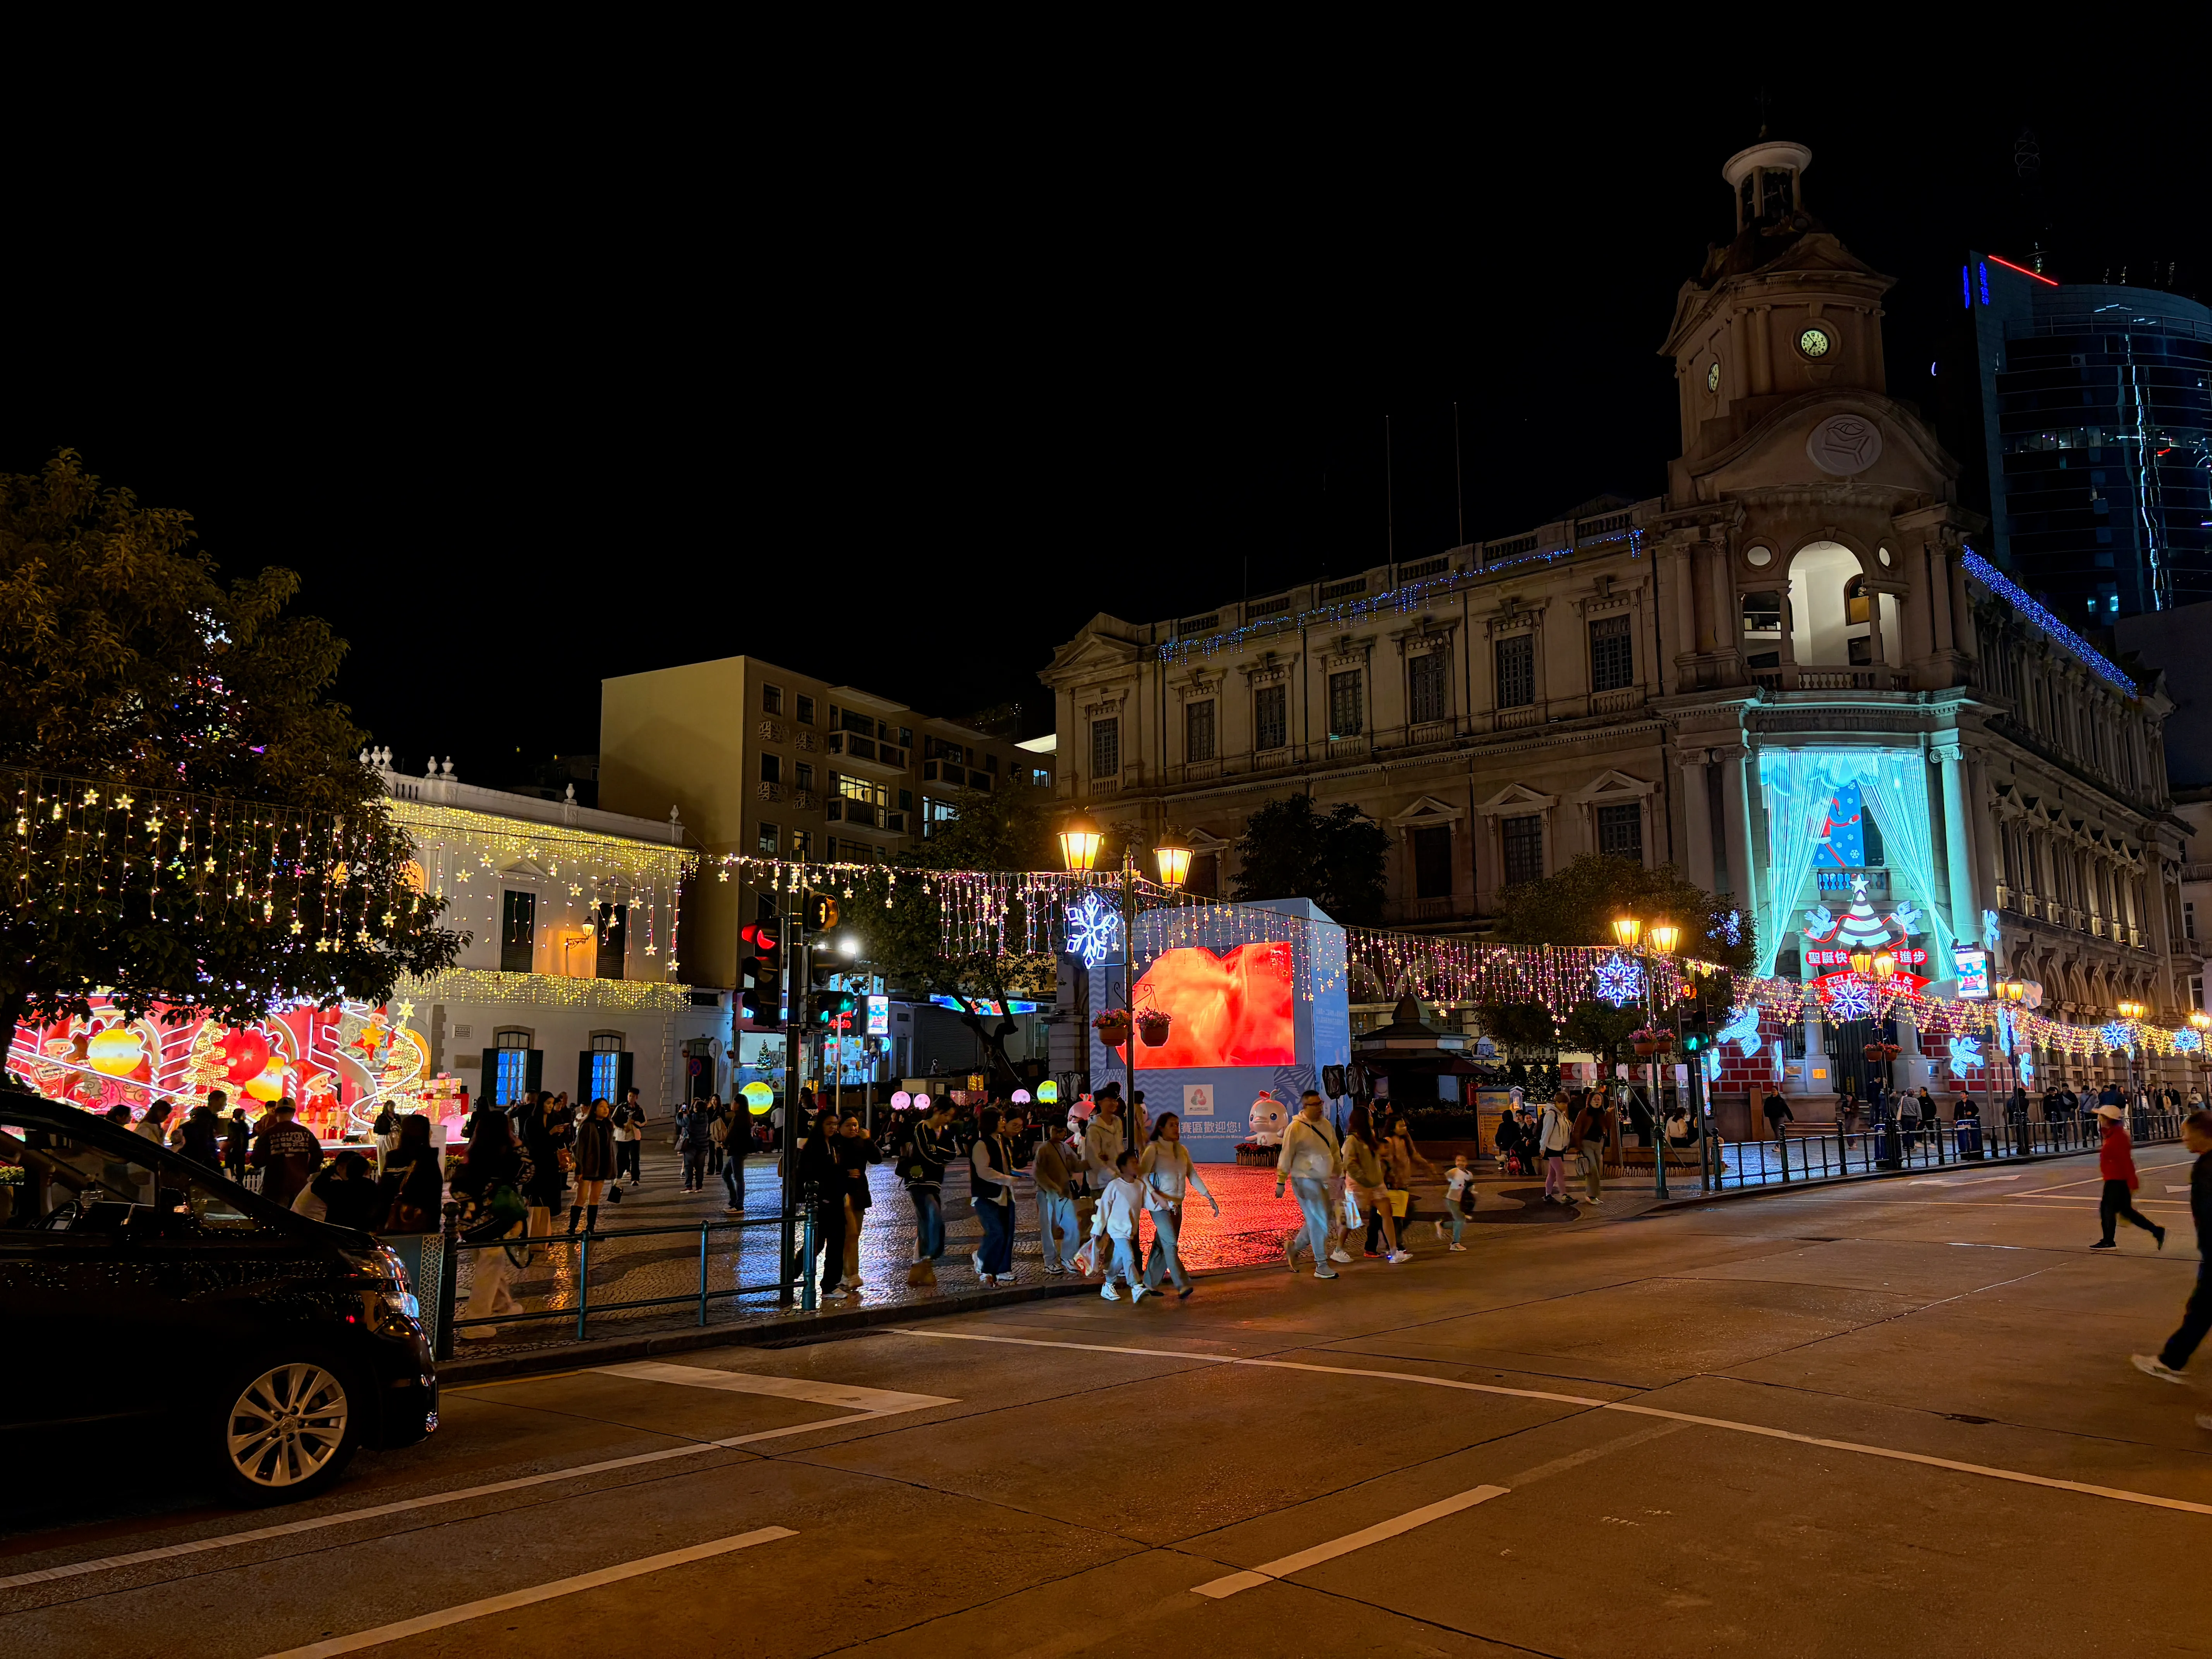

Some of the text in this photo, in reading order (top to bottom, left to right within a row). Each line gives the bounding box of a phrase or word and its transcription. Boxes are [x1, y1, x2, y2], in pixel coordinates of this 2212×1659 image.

[1808, 951, 1851, 964] 聖誕快
[1903, 976, 1913, 985] &
[829, 1019, 851, 1029] 牛奶
[1178, 1121, 1241, 1133] 賽區歡迎您!
